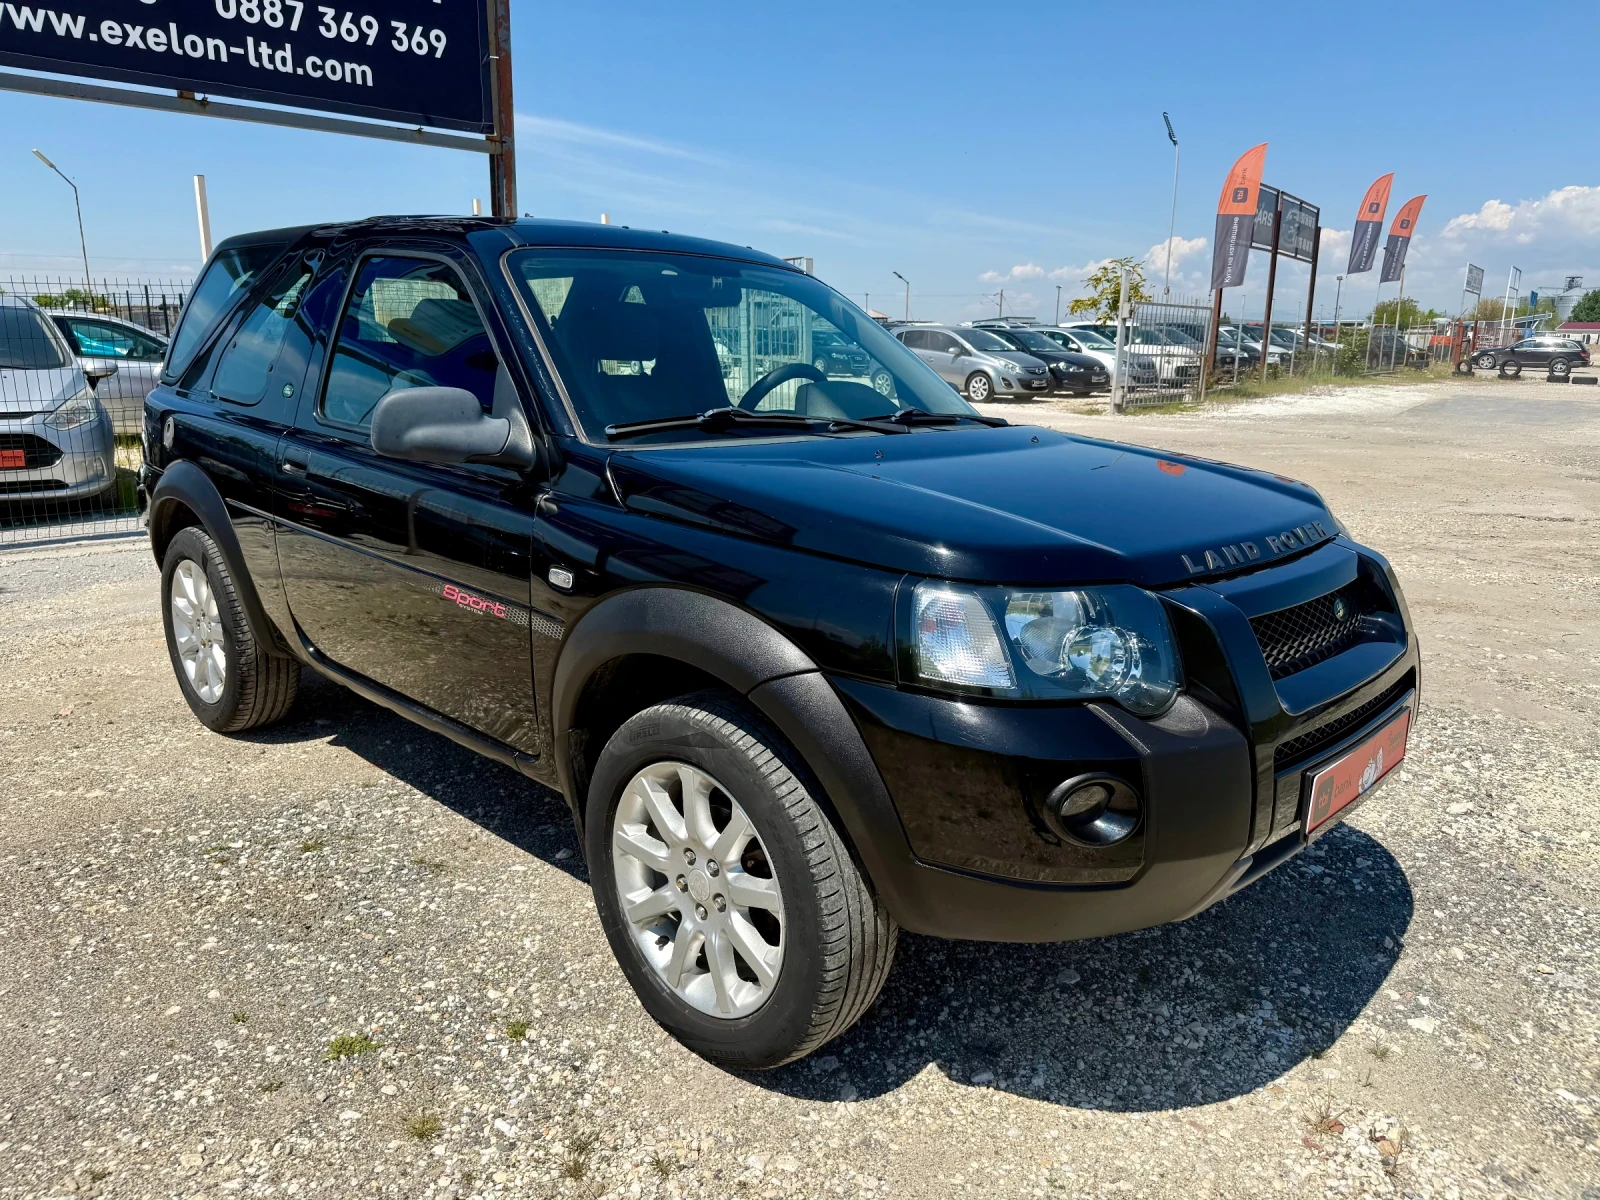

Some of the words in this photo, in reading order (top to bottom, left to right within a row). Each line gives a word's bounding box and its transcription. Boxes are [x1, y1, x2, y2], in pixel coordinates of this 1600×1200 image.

[0, 2, 374, 87] ww.exelon-ltd.com
[214, 0, 304, 32] 0887
[317, 5, 379, 46] 369
[390, 20, 447, 59] 369
[1239, 167, 1248, 185] bank
[1180, 541, 1261, 574] LAND
[1265, 520, 1328, 554] ROVER
[442, 584, 506, 619] Sport
[1334, 774, 1353, 798] bank
